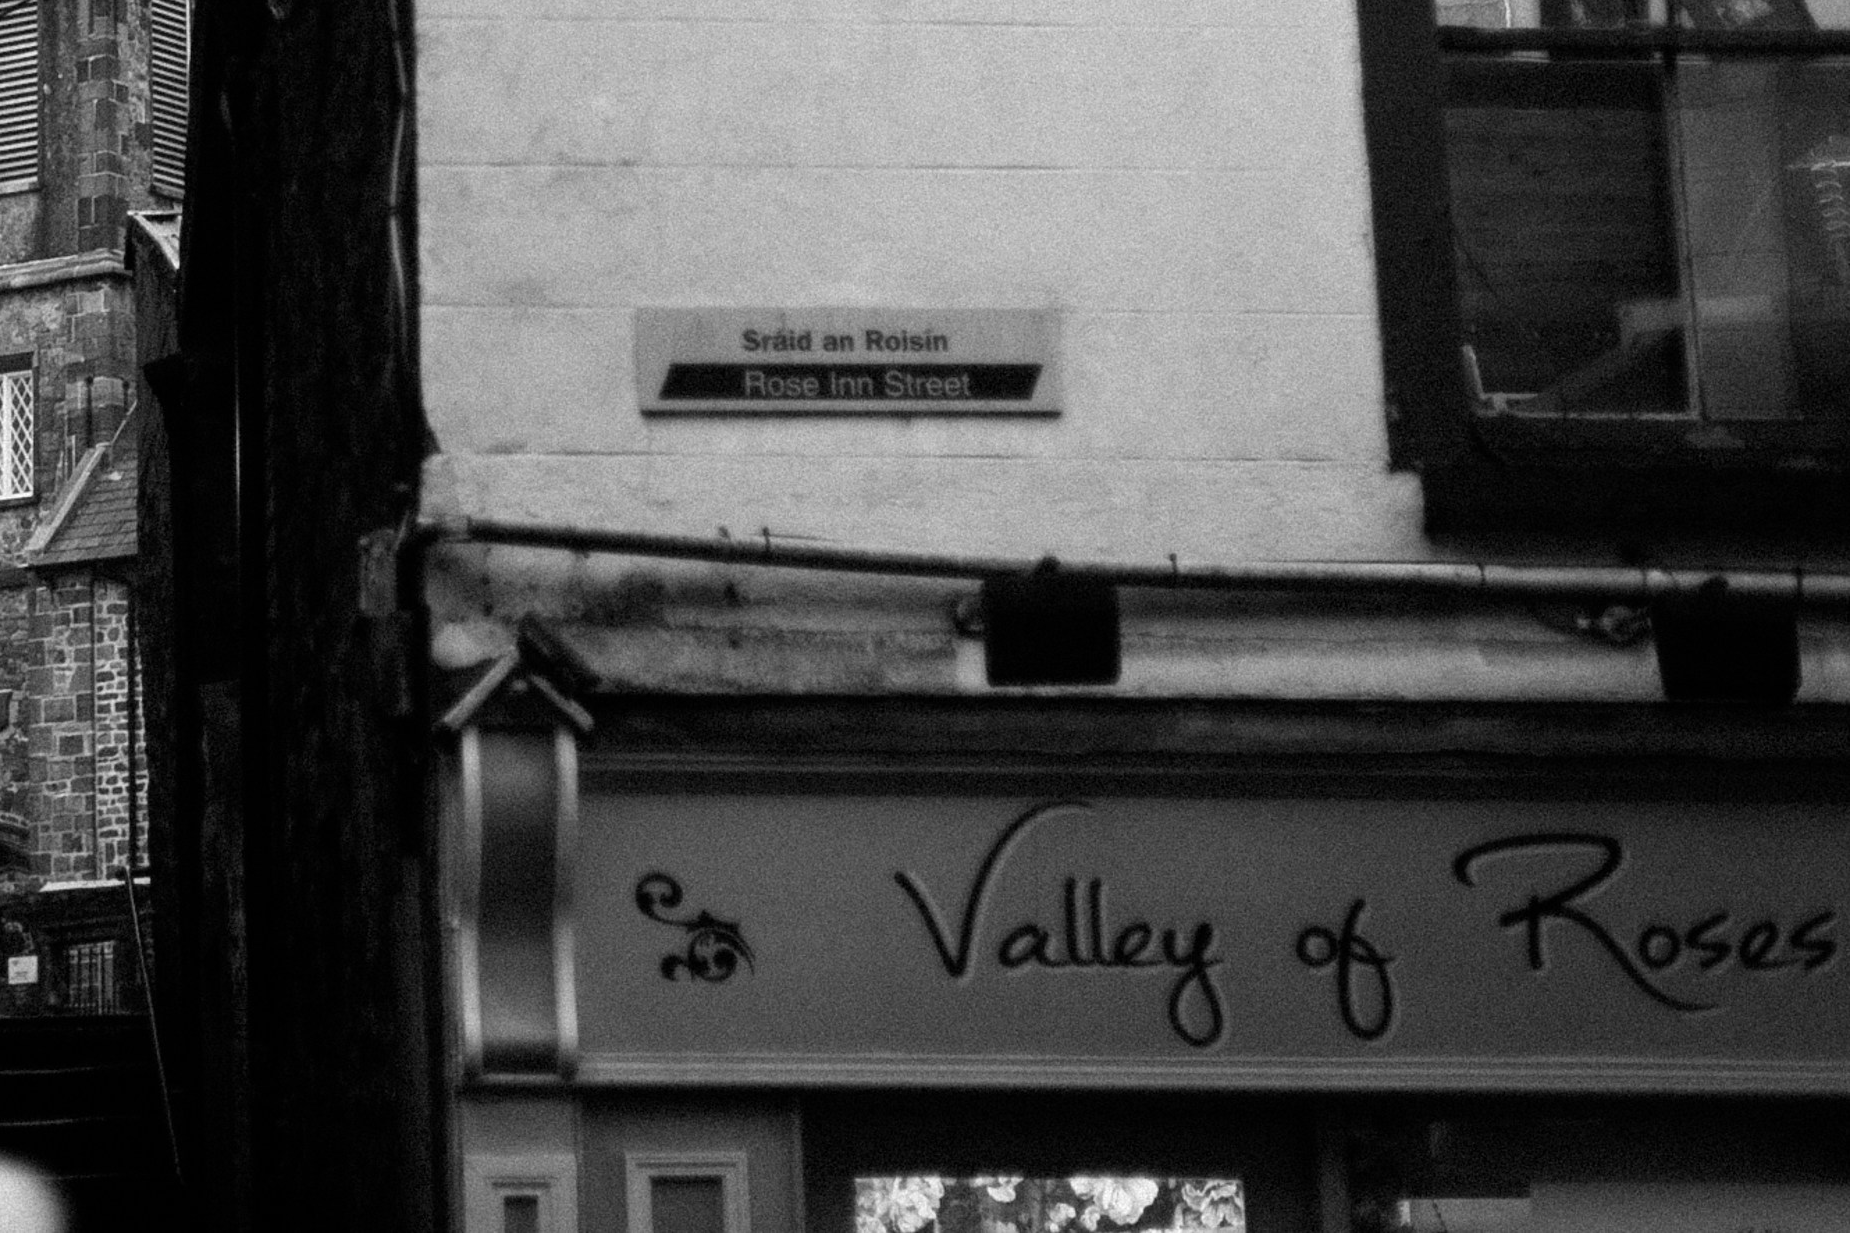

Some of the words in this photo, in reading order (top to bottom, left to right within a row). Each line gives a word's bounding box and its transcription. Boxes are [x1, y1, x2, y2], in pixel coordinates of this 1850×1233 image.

[742, 328, 812, 352] Sráid
[823, 334, 854, 352] an
[745, 370, 820, 397] Rose
[831, 371, 873, 396] Inn
[885, 370, 970, 397] Street
[894, 801, 1225, 1047] Valley
[1295, 898, 1396, 1042] of
[1453, 832, 1838, 1013] Roses
